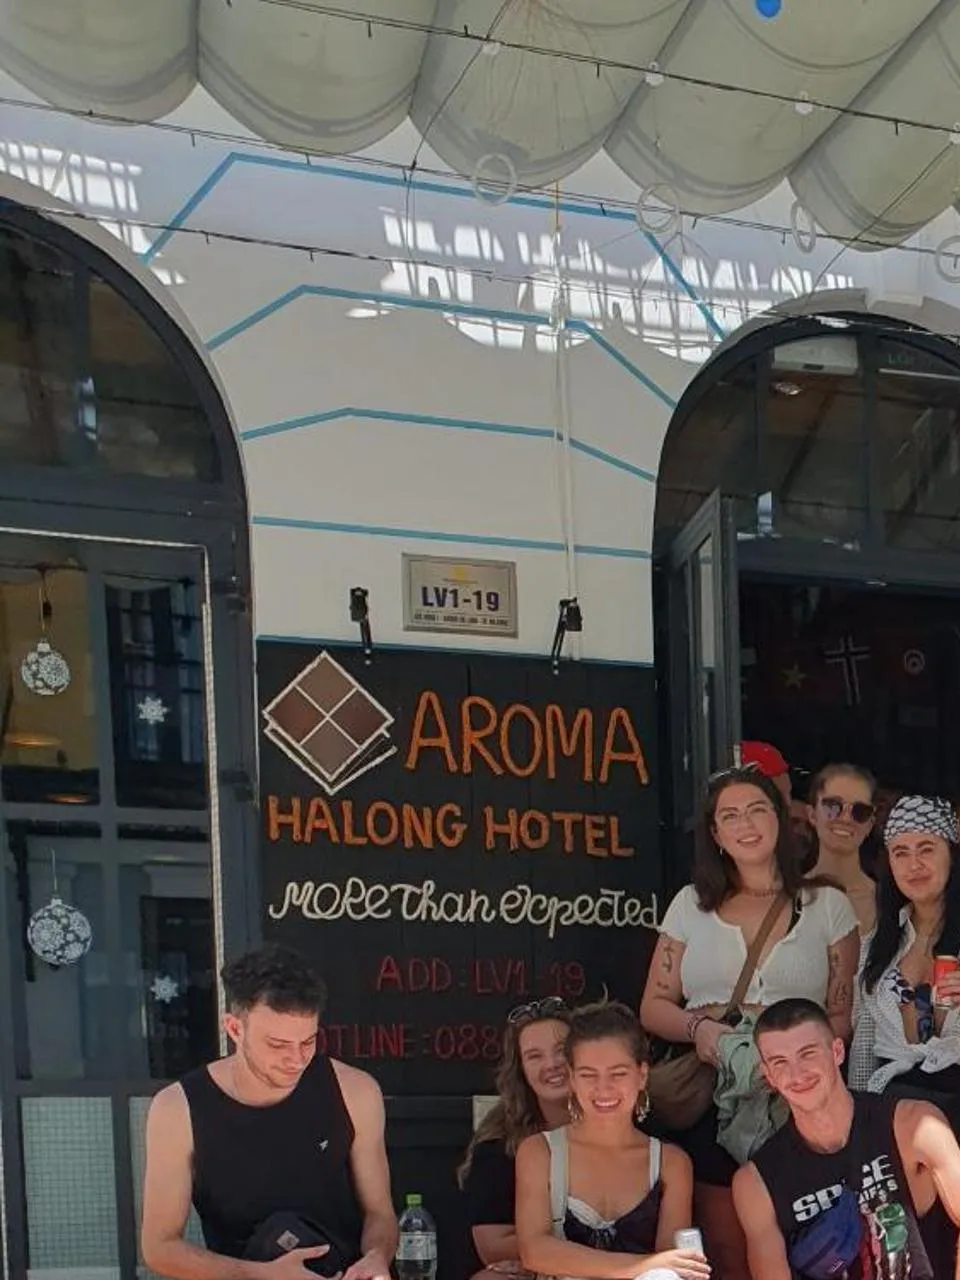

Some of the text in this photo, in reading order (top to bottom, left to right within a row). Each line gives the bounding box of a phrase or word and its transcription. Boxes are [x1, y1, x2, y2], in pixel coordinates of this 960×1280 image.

[422, 586, 500, 612] LV1-19
[404, 690, 649, 785] AROMA
[266, 794, 635, 857] HALONG HOTEL
